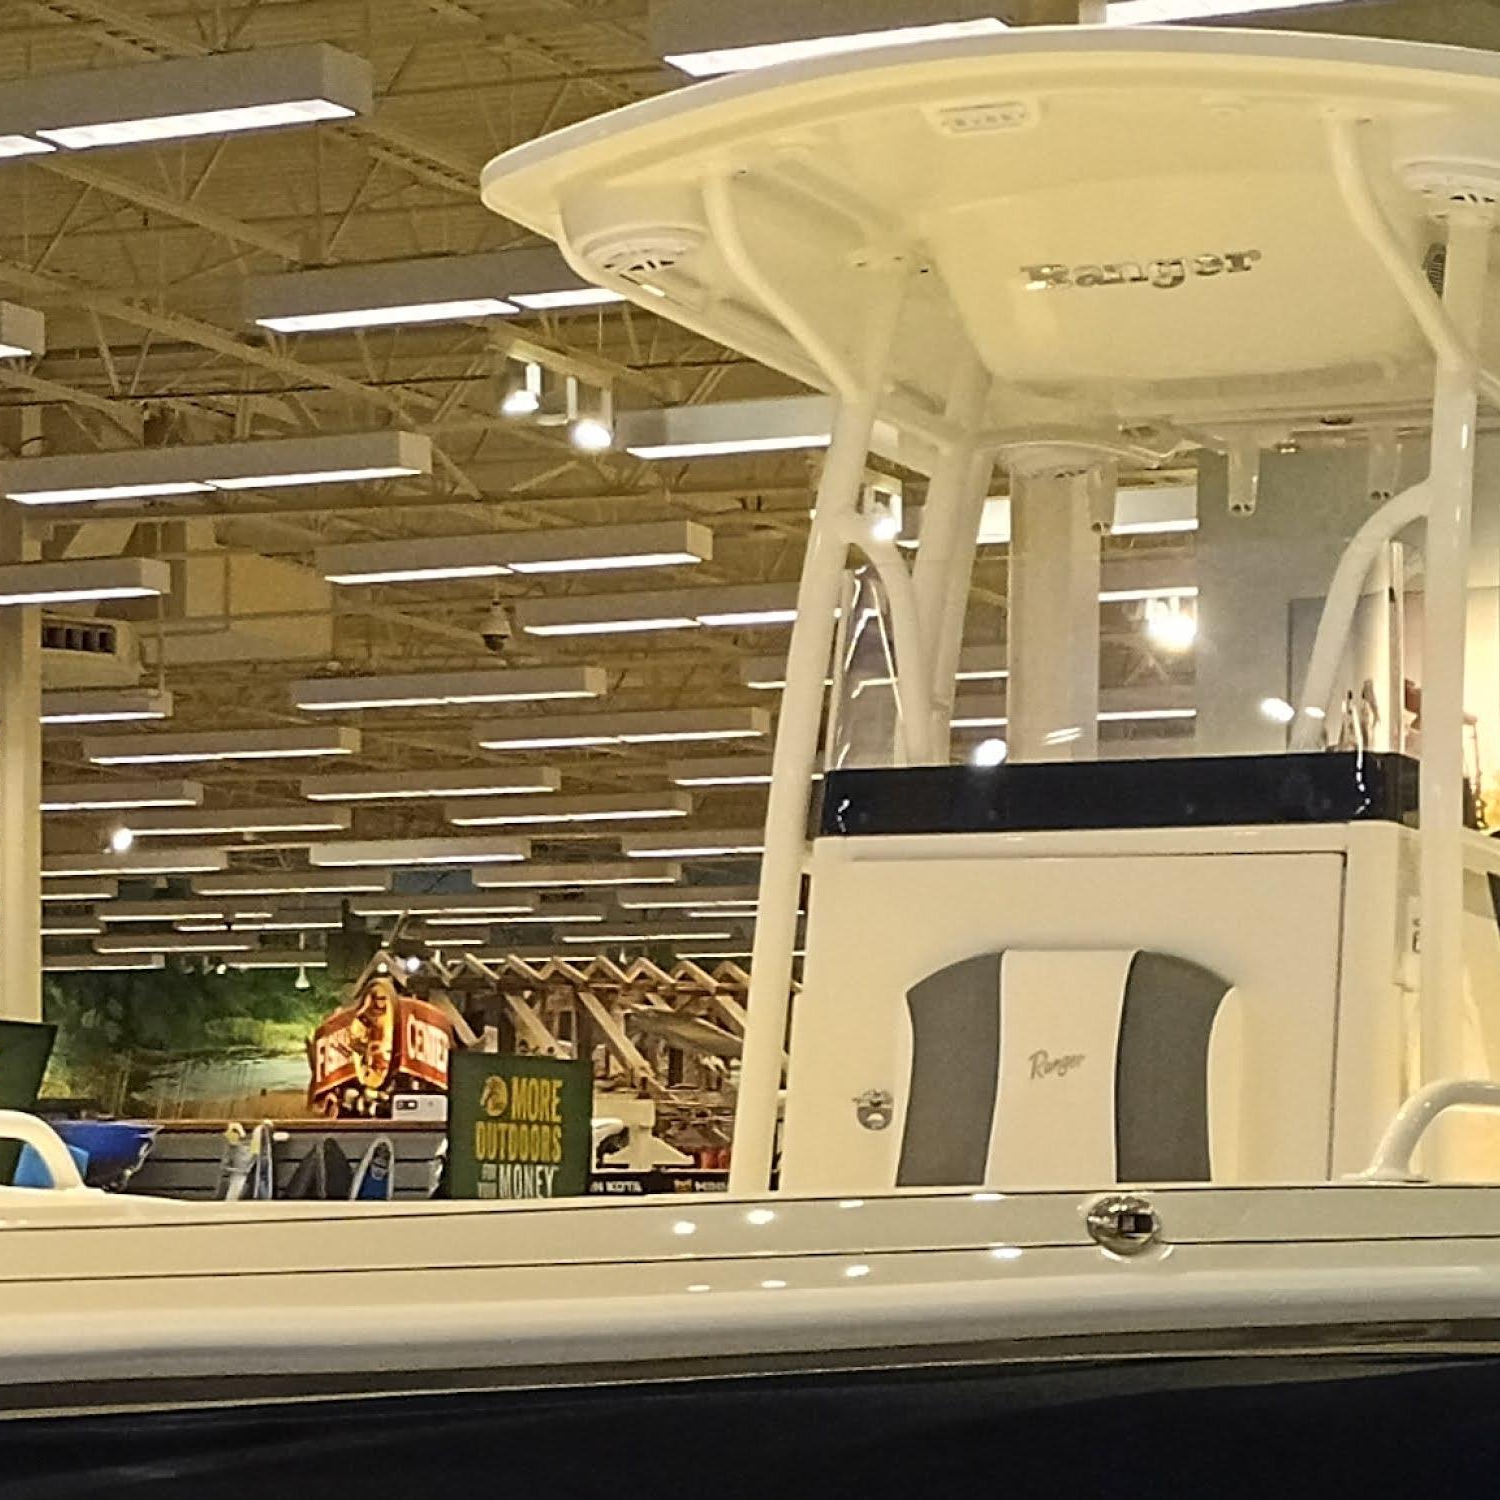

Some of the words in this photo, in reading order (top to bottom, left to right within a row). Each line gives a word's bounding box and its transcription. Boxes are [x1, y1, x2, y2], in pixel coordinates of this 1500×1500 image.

[1019, 248, 1262, 289] Ranger
[1028, 1049, 1087, 1080] Ranger
[511, 1076, 563, 1122] MORE
[475, 1120, 562, 1163] OUTDOORS
